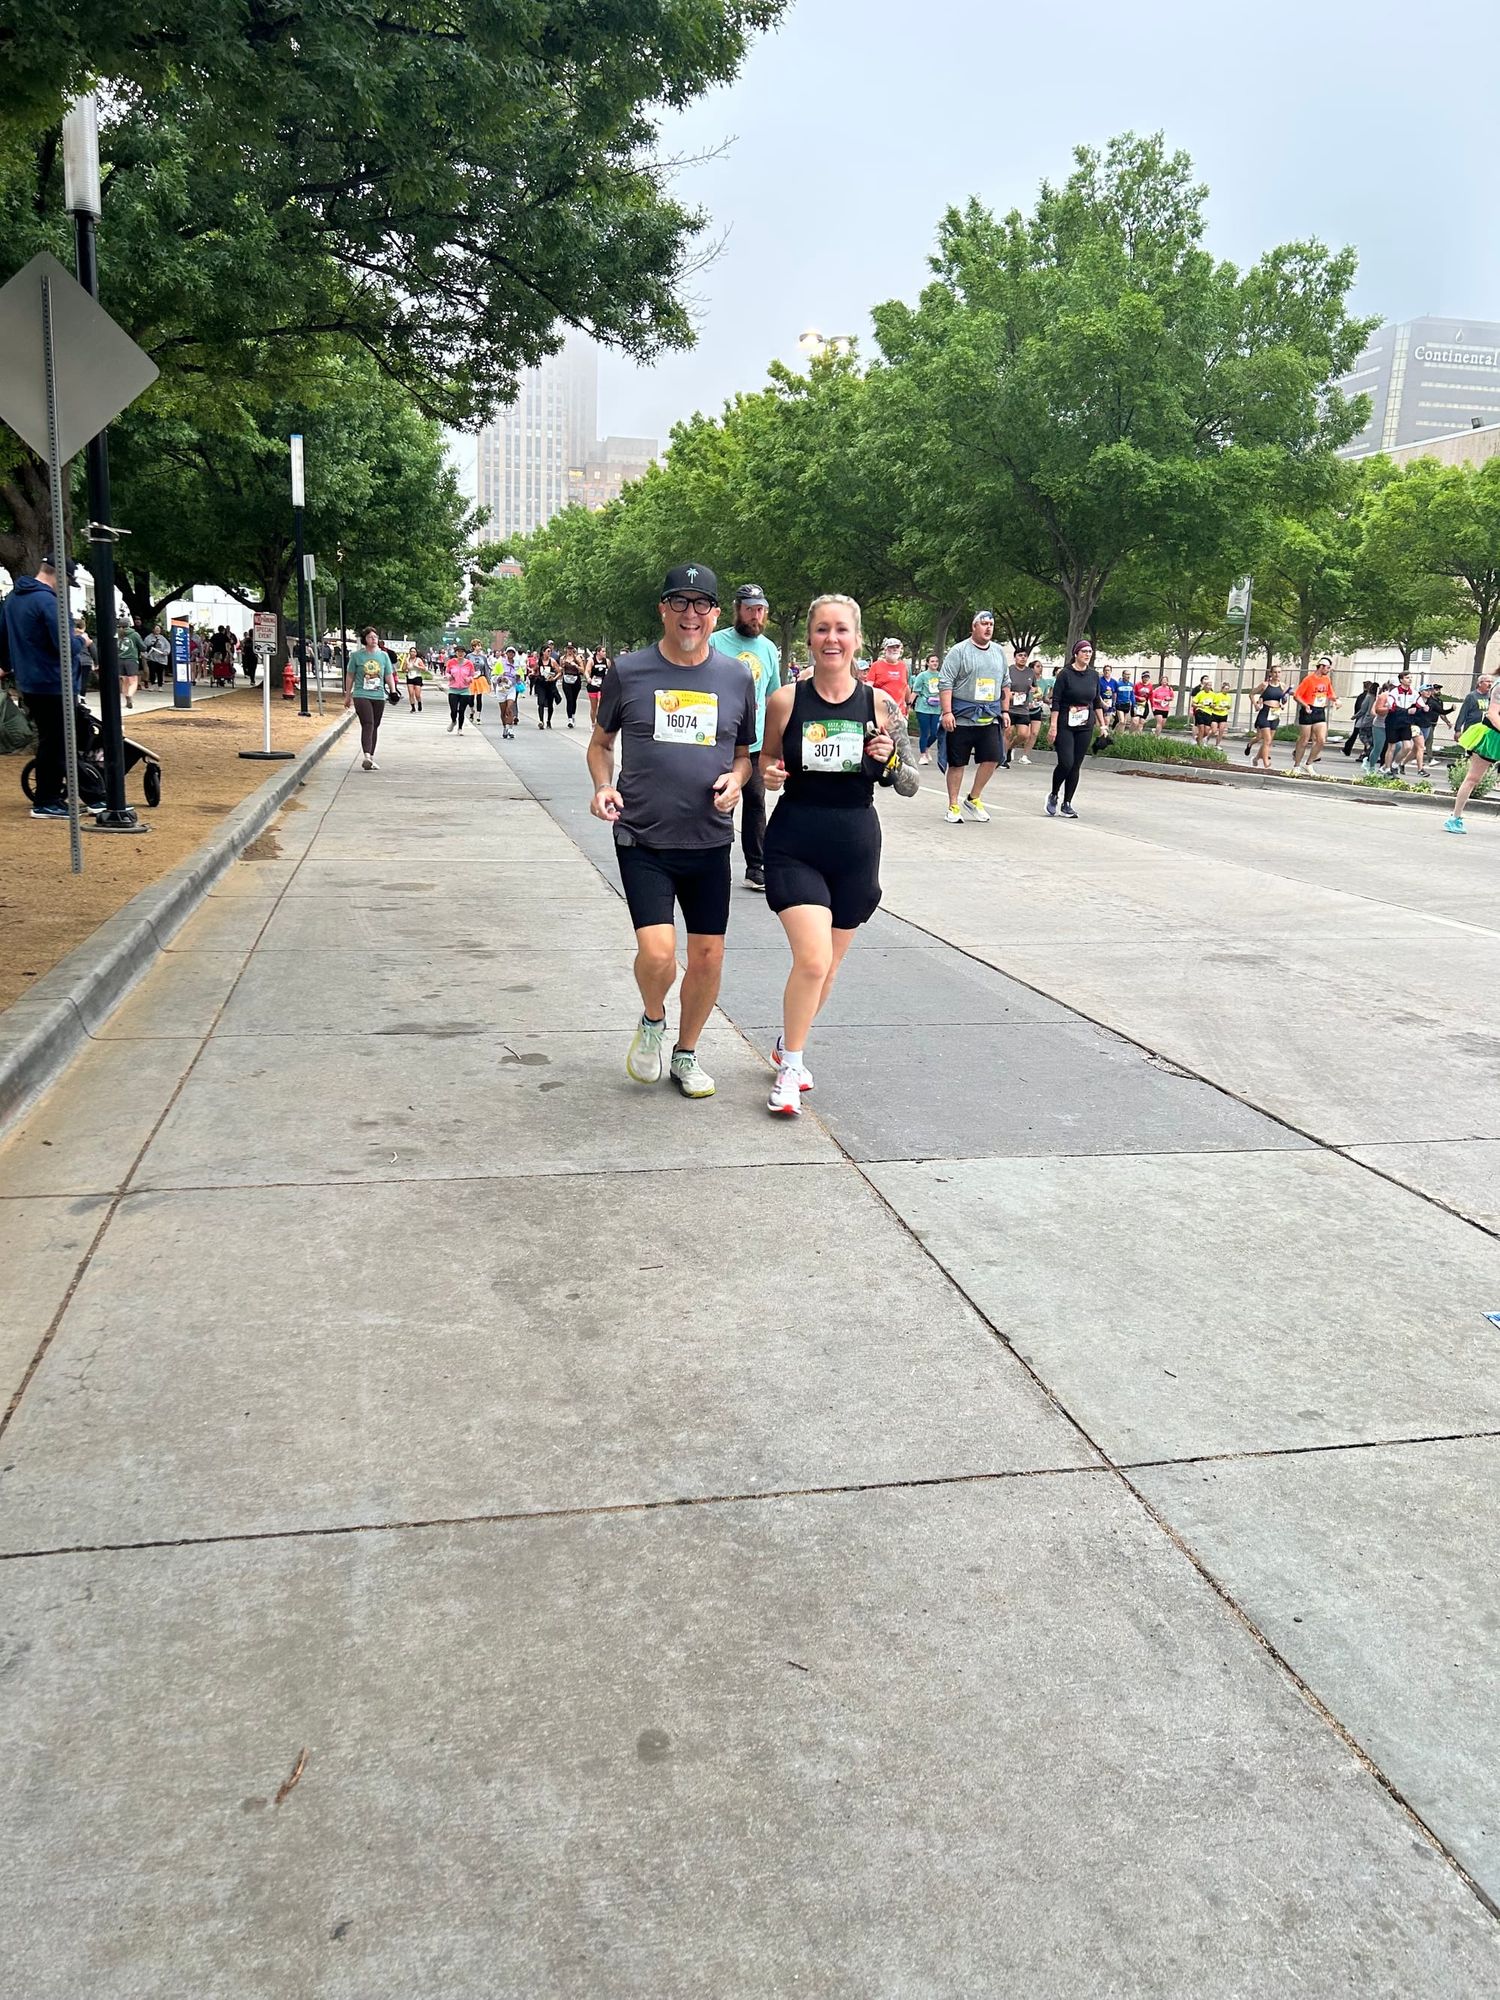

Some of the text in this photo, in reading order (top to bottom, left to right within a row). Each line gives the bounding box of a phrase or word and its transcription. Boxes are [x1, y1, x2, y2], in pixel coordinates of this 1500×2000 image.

[1414, 345, 1498, 367] Continental
[666, 714, 698, 729] 16074
[814, 744, 840, 757] 3071
